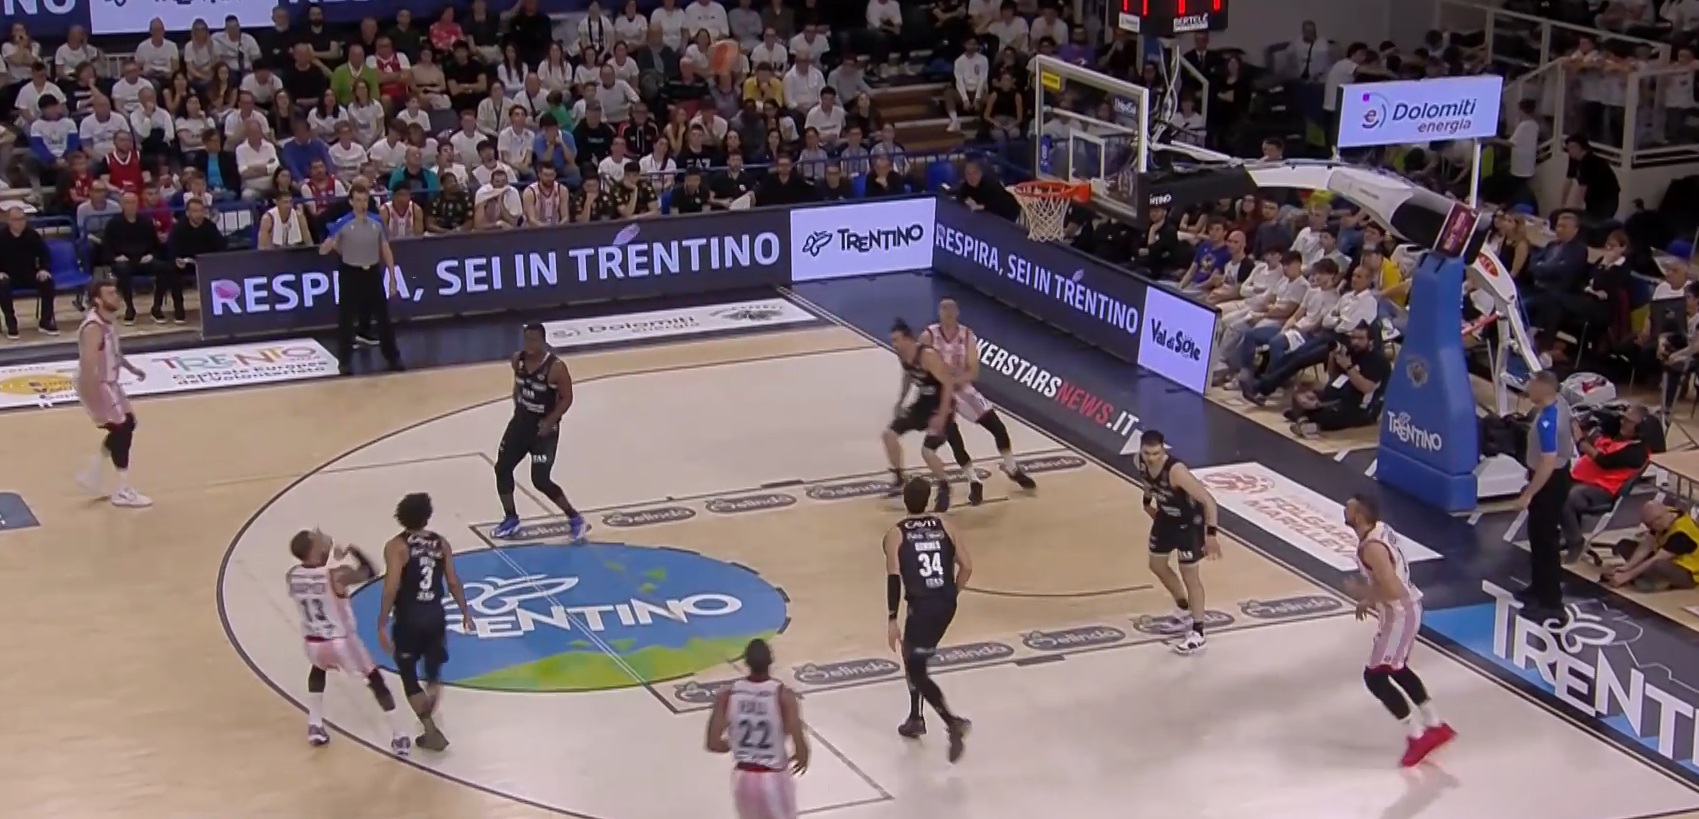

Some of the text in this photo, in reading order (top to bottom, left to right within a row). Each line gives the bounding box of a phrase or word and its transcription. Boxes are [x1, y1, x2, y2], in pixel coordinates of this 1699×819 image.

[1392, 98, 1477, 121] Dolomiti
[1417, 118, 1472, 134] energia
[837, 224, 924, 253] TRENTINO
[210, 231, 780, 315] RESPIA, SEI IN TRENTINO
[935, 223, 1139, 334] RESPIRA, SEI IN TRENTINO
[1151, 317, 1167, 347] Val
[1174, 330, 1201, 361] Sole
[1387, 410, 1442, 452] TRENTINO
[420, 566, 434, 590] 3
[918, 552, 944, 577] 34
[739, 719, 773, 749] 22
